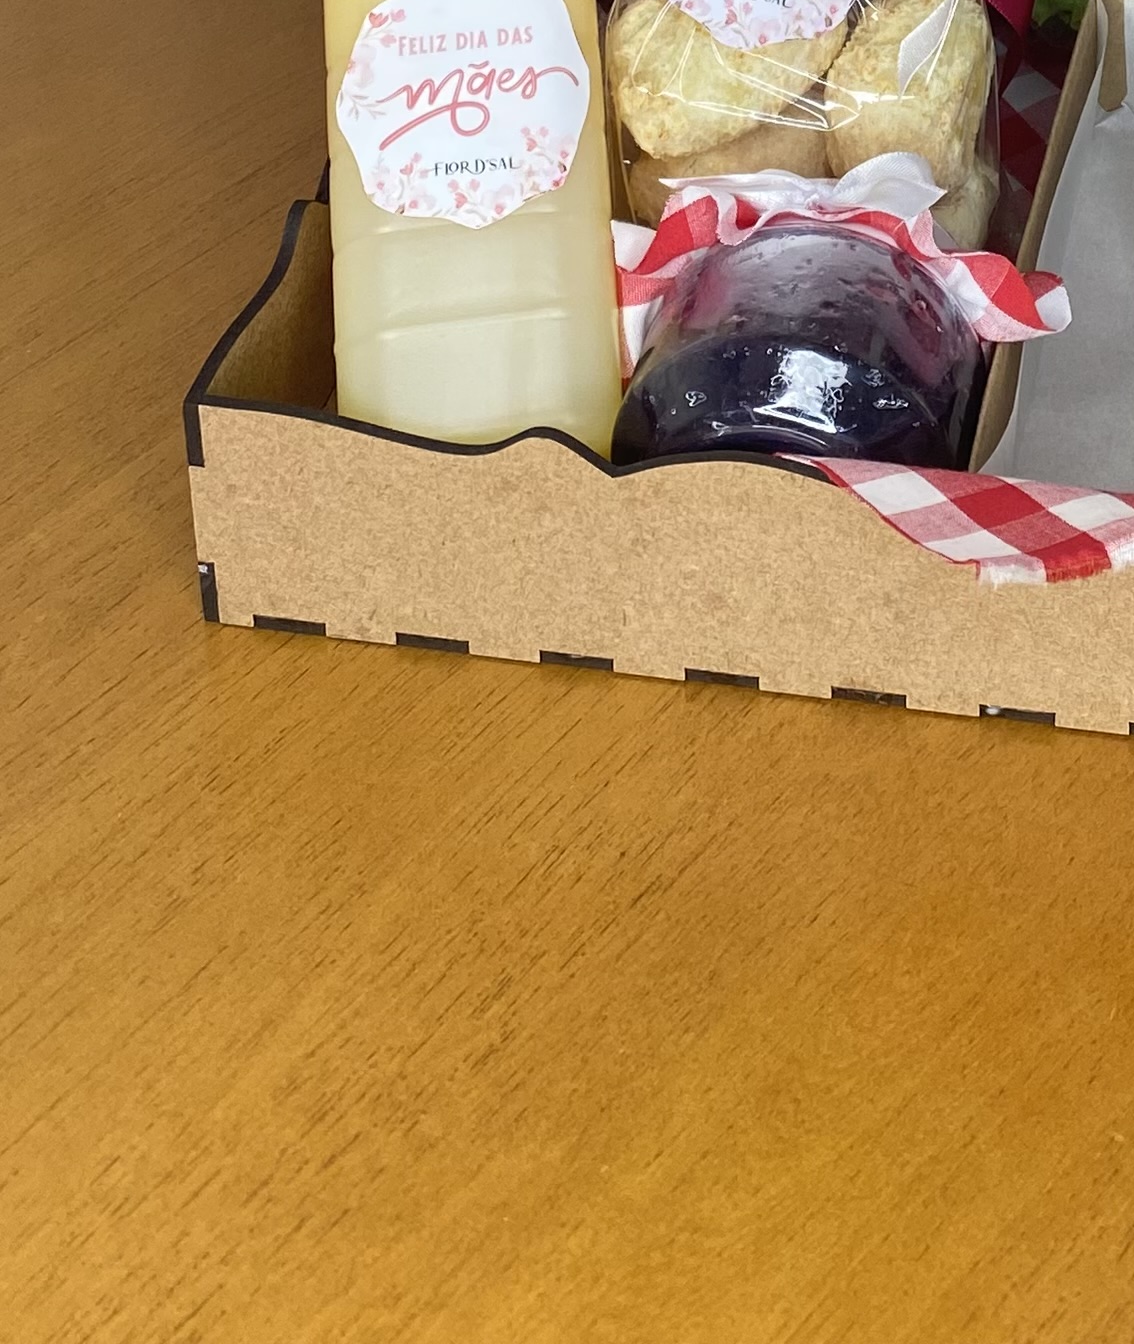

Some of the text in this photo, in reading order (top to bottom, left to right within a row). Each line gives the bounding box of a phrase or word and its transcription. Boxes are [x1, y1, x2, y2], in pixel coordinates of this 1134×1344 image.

[398, 25, 534, 56] FELIZ DIA DAS
[375, 60, 580, 152] mães
